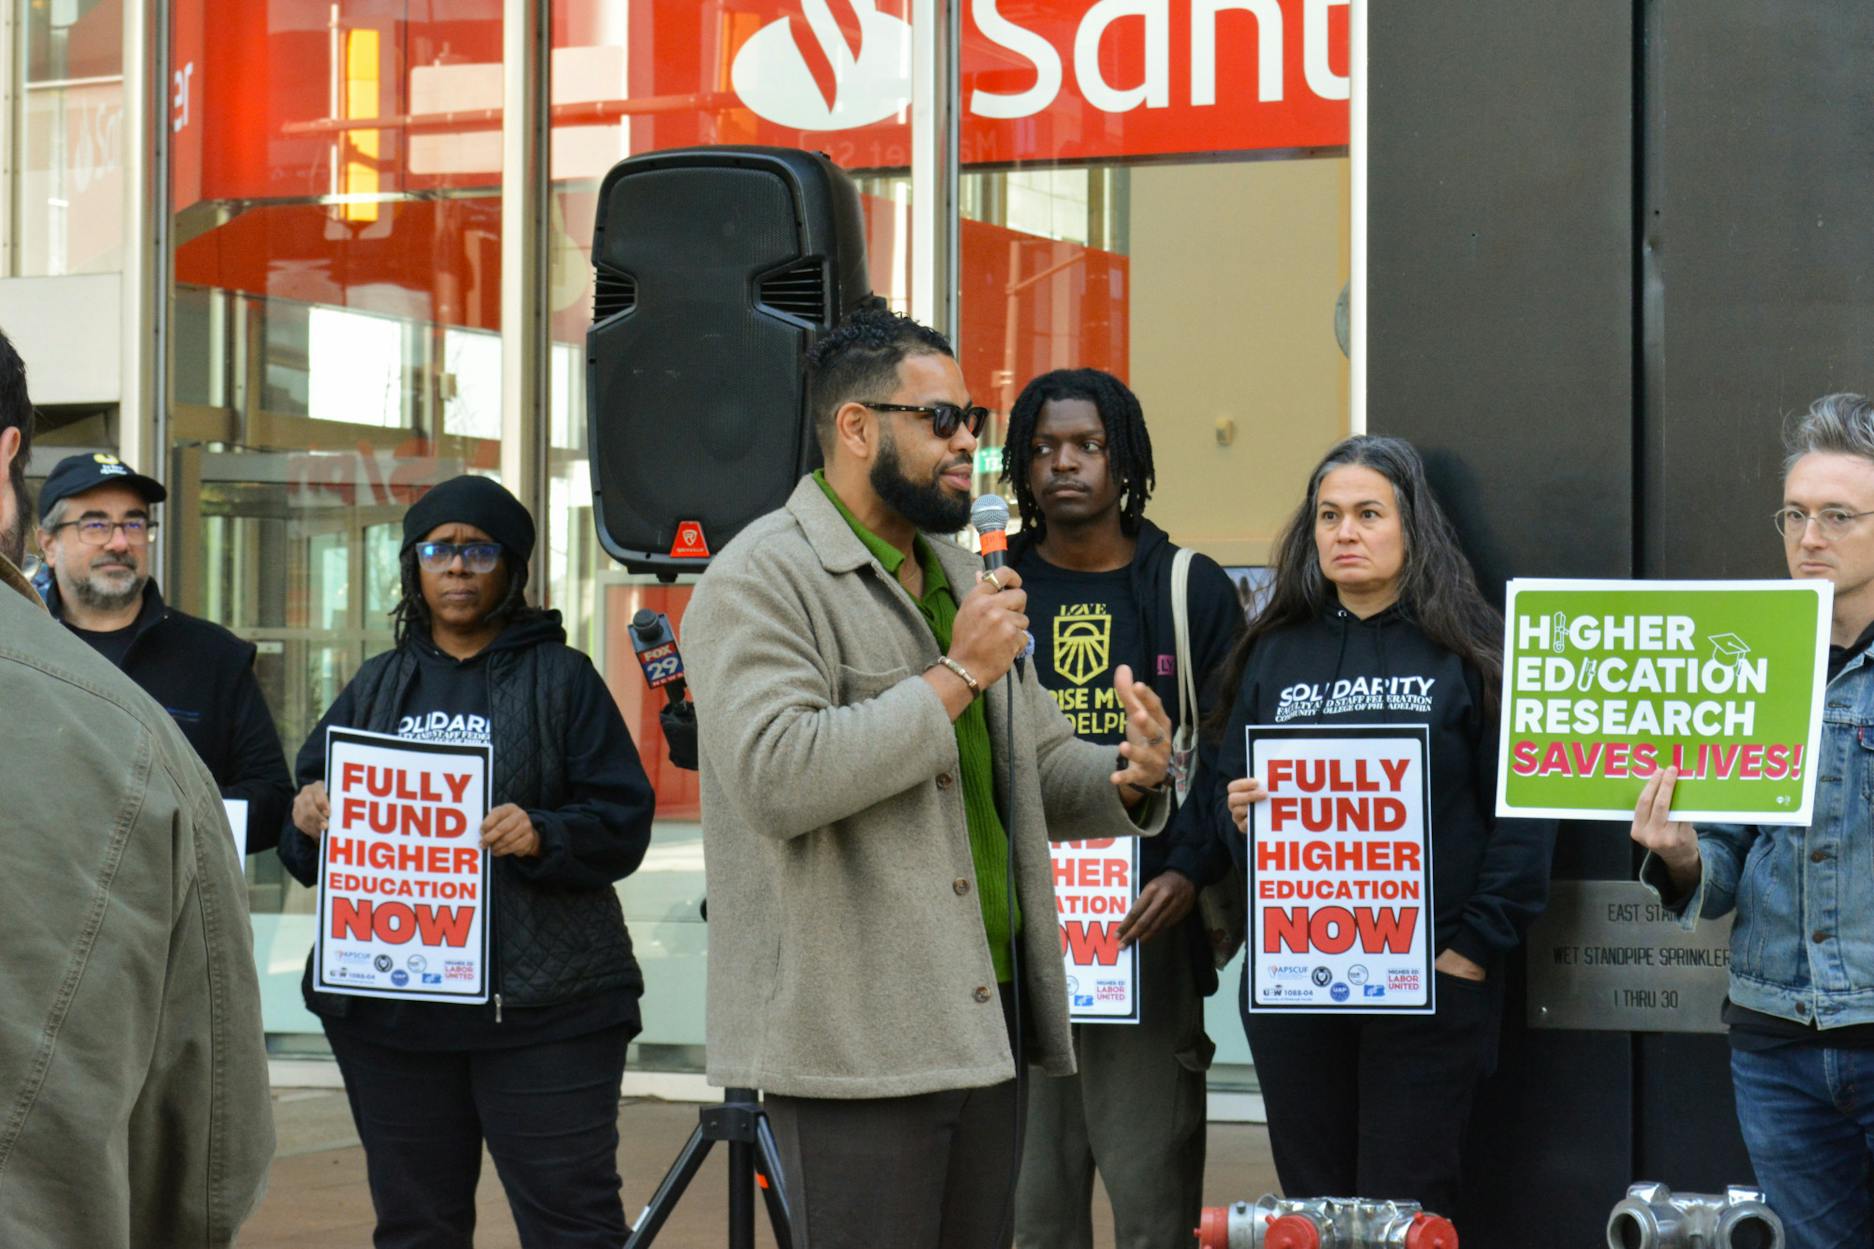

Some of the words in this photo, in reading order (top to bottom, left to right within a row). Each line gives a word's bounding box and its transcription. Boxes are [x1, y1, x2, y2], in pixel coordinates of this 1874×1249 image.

[647, 657, 679, 680] 29
[1323, 703, 1353, 714] OLLEGE
[1515, 698, 1755, 736] RESEARCH
[1267, 759, 1411, 792] FULLY
[1511, 741, 1659, 779] SAVES
[1672, 744, 1805, 781] LIVES!
[342, 762, 473, 803] FULLY
[342, 797, 467, 839] FUND
[1271, 797, 1407, 832] FUND
[329, 836, 480, 875] HIGHER
[1257, 840, 1421, 871] HIGHER
[329, 872, 477, 900] EDUCATION
[1259, 880, 1420, 900] EDUCATION
[331, 896, 476, 948] NOW
[1608, 904, 1641, 921] EAST
[1263, 905, 1419, 954] NOW
[1554, 948, 1579, 965] WET
[1584, 948, 1654, 966] STANDPIPE
[1388, 975, 1419, 983] LABOR
[1623, 990, 1657, 1008] THRU
[1661, 990, 1679, 1008] 30
